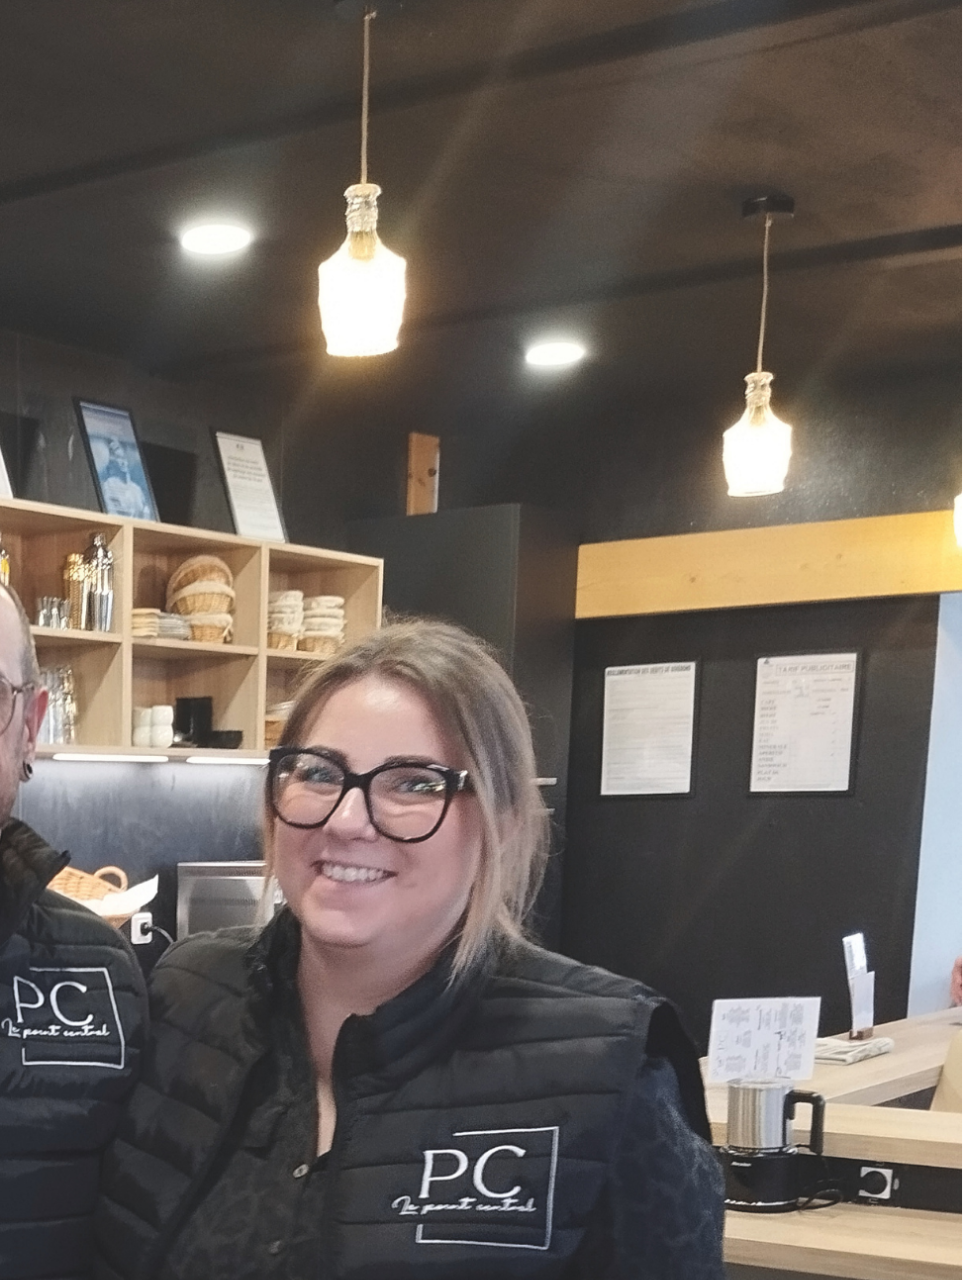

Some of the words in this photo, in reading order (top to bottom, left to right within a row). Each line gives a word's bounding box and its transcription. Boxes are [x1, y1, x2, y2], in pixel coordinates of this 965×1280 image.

[13, 975, 94, 1027] PC
[1, 1018, 21, 1038] Le
[23, 1025, 62, 1039] point
[62, 1023, 111, 1037] central
[418, 1144, 526, 1198] PC
[391, 1195, 420, 1215] Le
[420, 1197, 477, 1215] point
[476, 1197, 537, 1212] central
